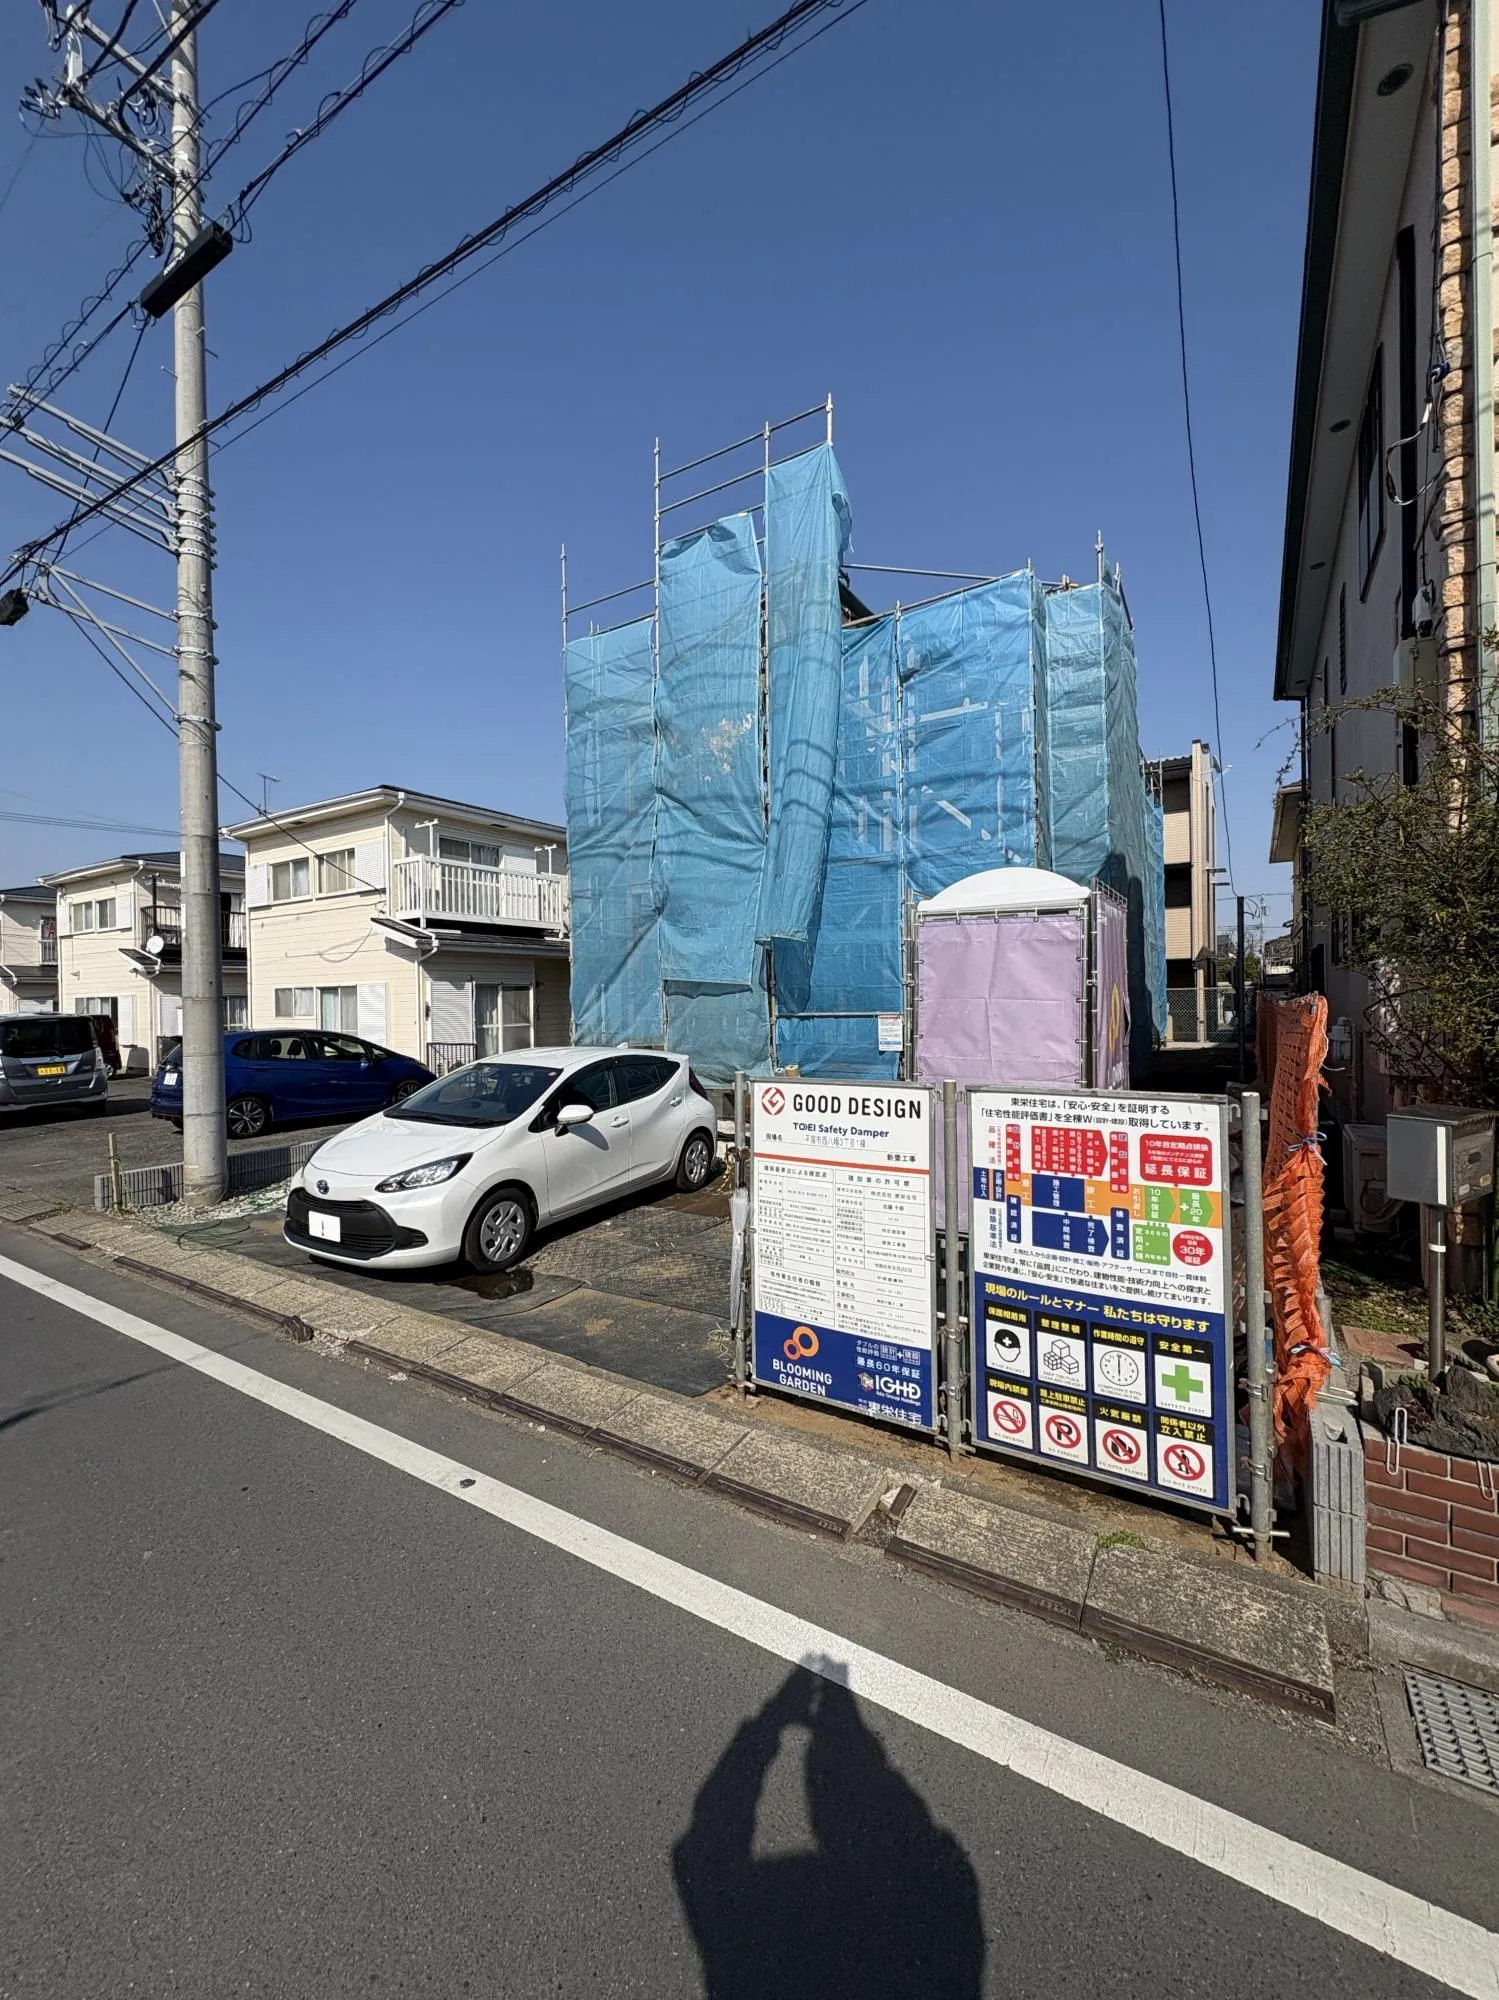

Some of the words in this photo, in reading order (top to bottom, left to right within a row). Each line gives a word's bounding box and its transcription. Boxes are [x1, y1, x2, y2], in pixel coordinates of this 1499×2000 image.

[793, 1093, 841, 1114] GOOD
[849, 1097, 921, 1119] DESIGN
[1010, 1097, 1170, 1116] 東栄住宅は、「安心・安全」を証明する
[818, 1124, 848, 1136] Safety
[850, 1126, 890, 1139] Damper
[887, 1153, 916, 1163] 新築工事
[1144, 1162, 1208, 1180] 延長保証
[980, 1170, 988, 1198] 土地仕入
[1052, 1178, 1060, 1207] 施工管理
[1150, 1188, 1161, 1219] 10年保証
[1190, 1192, 1203, 1223] 最長20年
[1063, 1218, 1071, 1249] 中間検査
[1087, 1221, 1096, 1253] 完了検査
[1116, 1210, 1125, 1258] 検査済証
[1180, 1245, 1206, 1257] 30年
[984, 1282, 1100, 1312] 現場のルールとマナー
[1103, 1305, 1210, 1333] 私たちは守ります
[988, 1306, 1027, 1323] 保護帽着用
[1041, 1318, 1081, 1334] 整理整頓
[1158, 1340, 1205, 1354] 安全第一
[772, 1358, 833, 1385] BLOOMING
[856, 1356, 921, 1380] 最長60年保証
[779, 1373, 826, 1397] GARDEN
[867, 1400, 922, 1425] 東栄住宅
[1099, 1406, 1142, 1424] 火気厳禁
[1160, 1415, 1206, 1433] 関係者以外
[1160, 1425, 1207, 1443] 立入禁止
